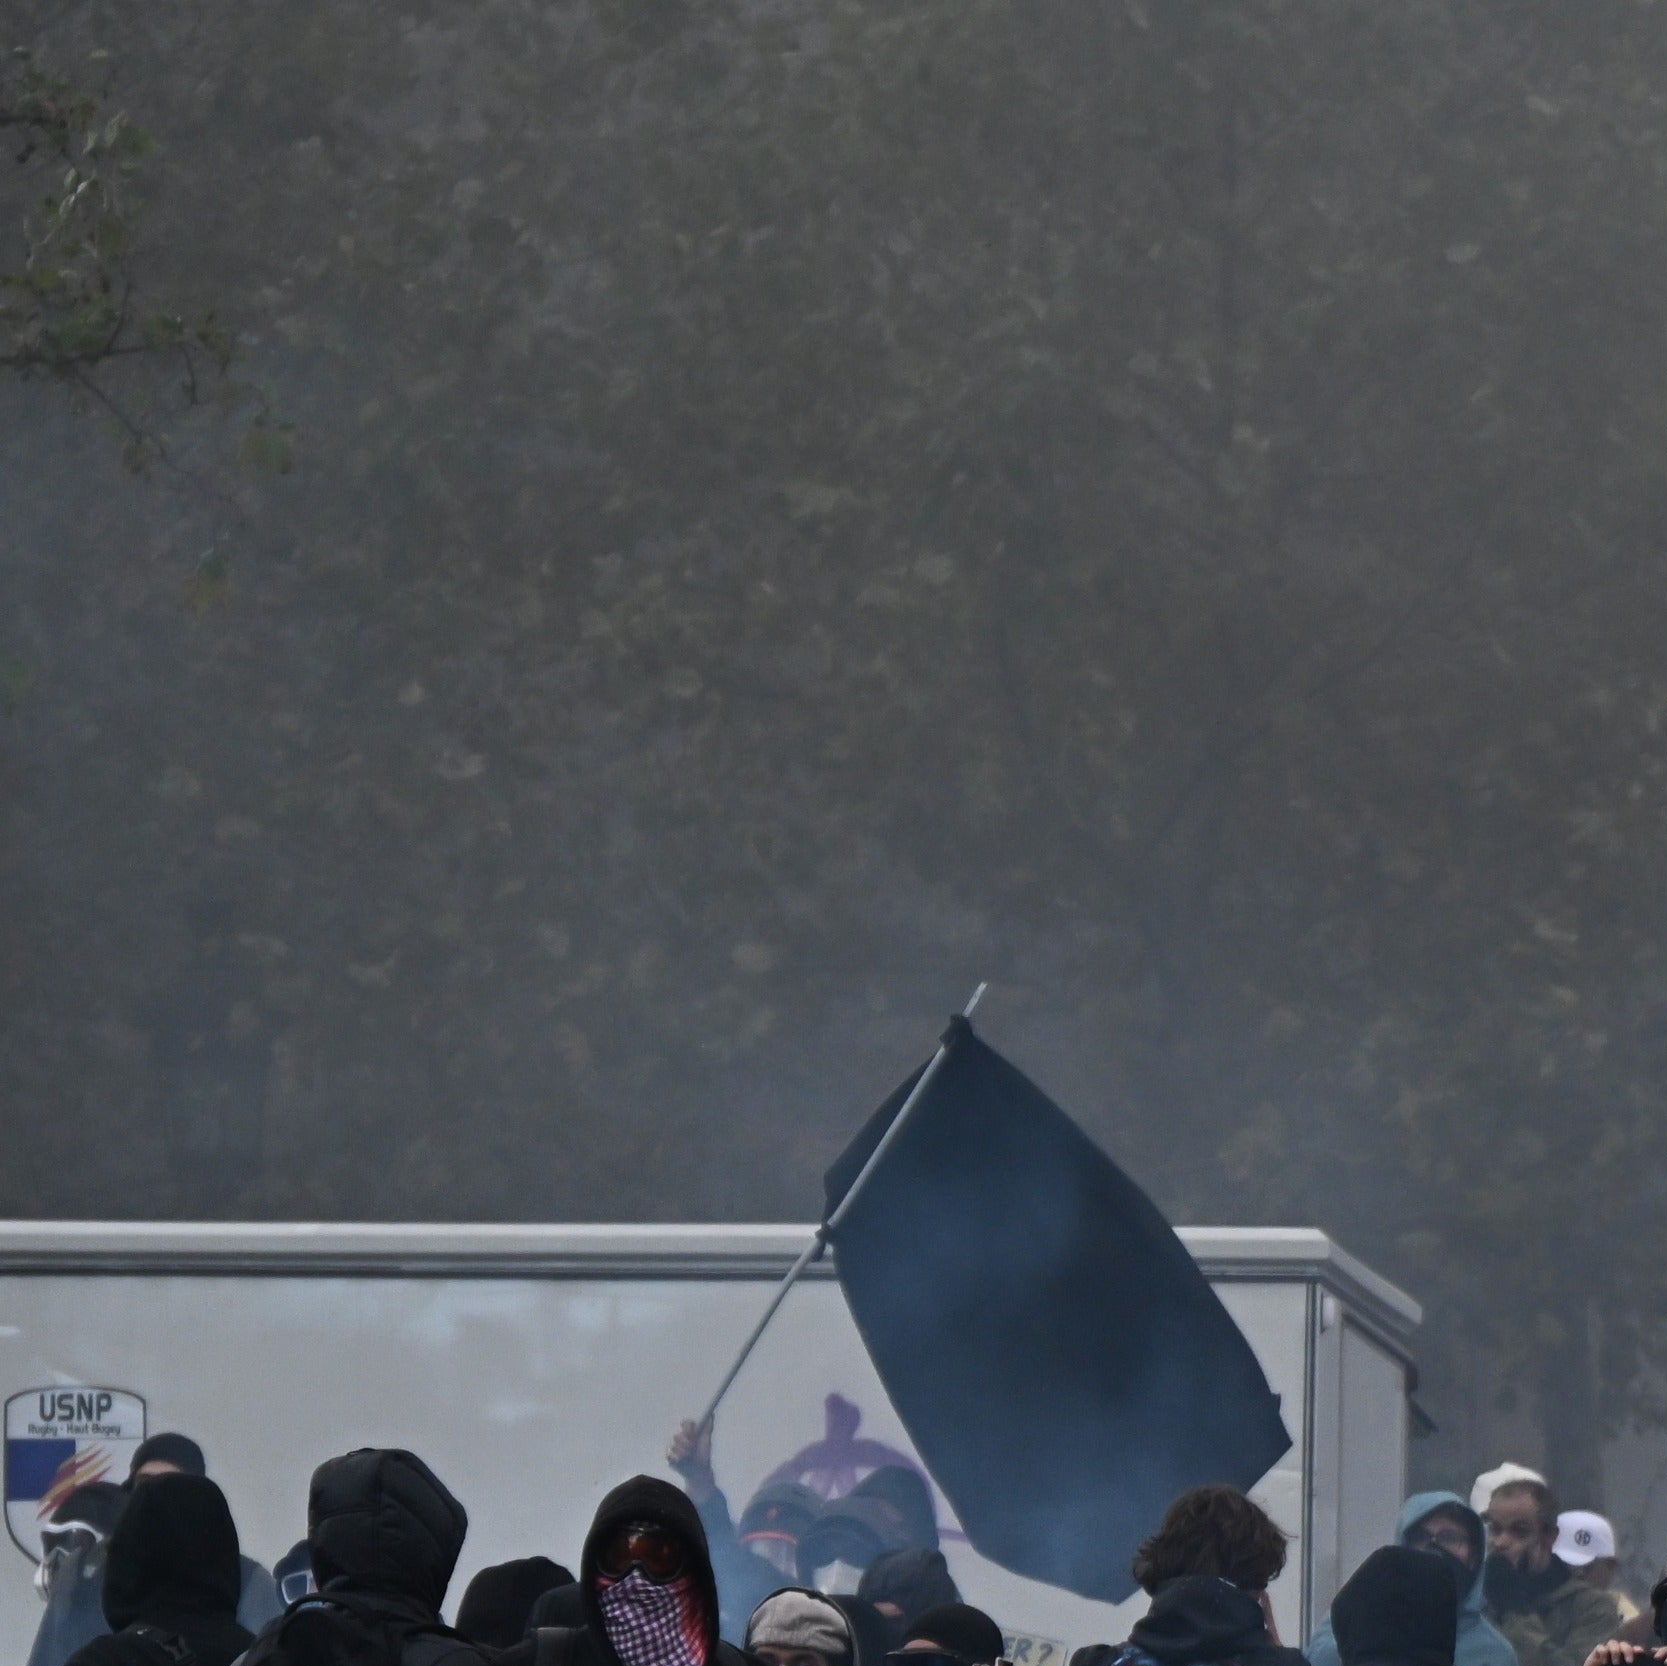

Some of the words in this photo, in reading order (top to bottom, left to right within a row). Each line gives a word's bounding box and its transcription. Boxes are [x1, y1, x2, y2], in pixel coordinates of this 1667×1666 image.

[38, 1392, 112, 1422] USNP
[27, 1423, 58, 1437] Rugby
[66, 1423, 89, 1434] Haut
